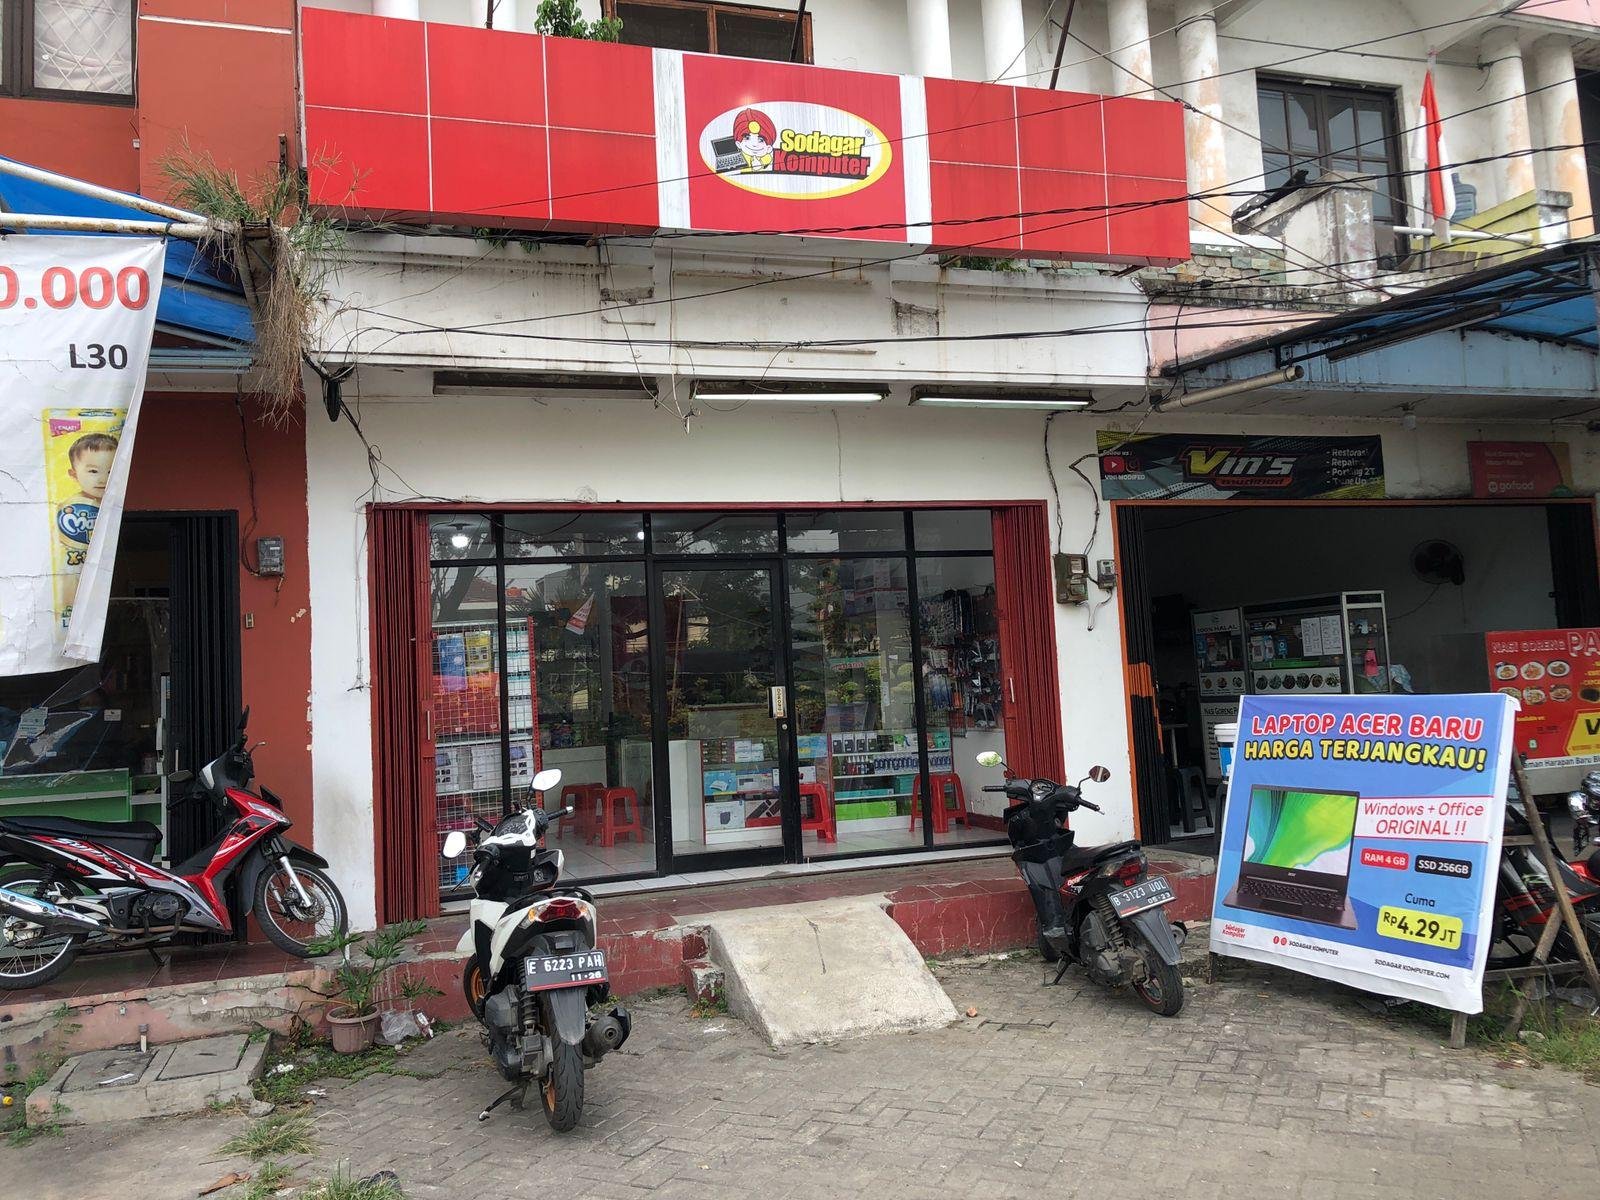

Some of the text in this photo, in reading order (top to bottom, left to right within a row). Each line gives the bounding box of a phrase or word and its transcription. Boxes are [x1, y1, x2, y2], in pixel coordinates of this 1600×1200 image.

[780, 129, 865, 157] Sodagar
[773, 148, 870, 176] Komputer
[69, 343, 128, 370] L30
[1251, 713, 1484, 742] LAPTOP ACER BARU
[1244, 739, 1313, 760] HARGA
[1319, 739, 1487, 772] TERJANGKAU!
[1364, 802, 1424, 816] Windows
[1439, 802, 1484, 816] Office
[1376, 819, 1450, 835] ORIGINAL
[1364, 853, 1406, 866] RAM 4 GB
[1418, 859, 1469, 874] SSD 256GB
[1113, 896, 1121, 906] B
[1123, 887, 1145, 902] 3123
[1404, 893, 1436, 907] Cuma
[1222, 929, 1246, 939] Komputer
[1225, 924, 1245, 934] Sodagar
[1288, 940, 1339, 956] SODAGAR KOMPUTER
[529, 955, 601, 974] E 6223 PAH
[1374, 958, 1450, 979] SODAGAR KOMPUTER.COM
